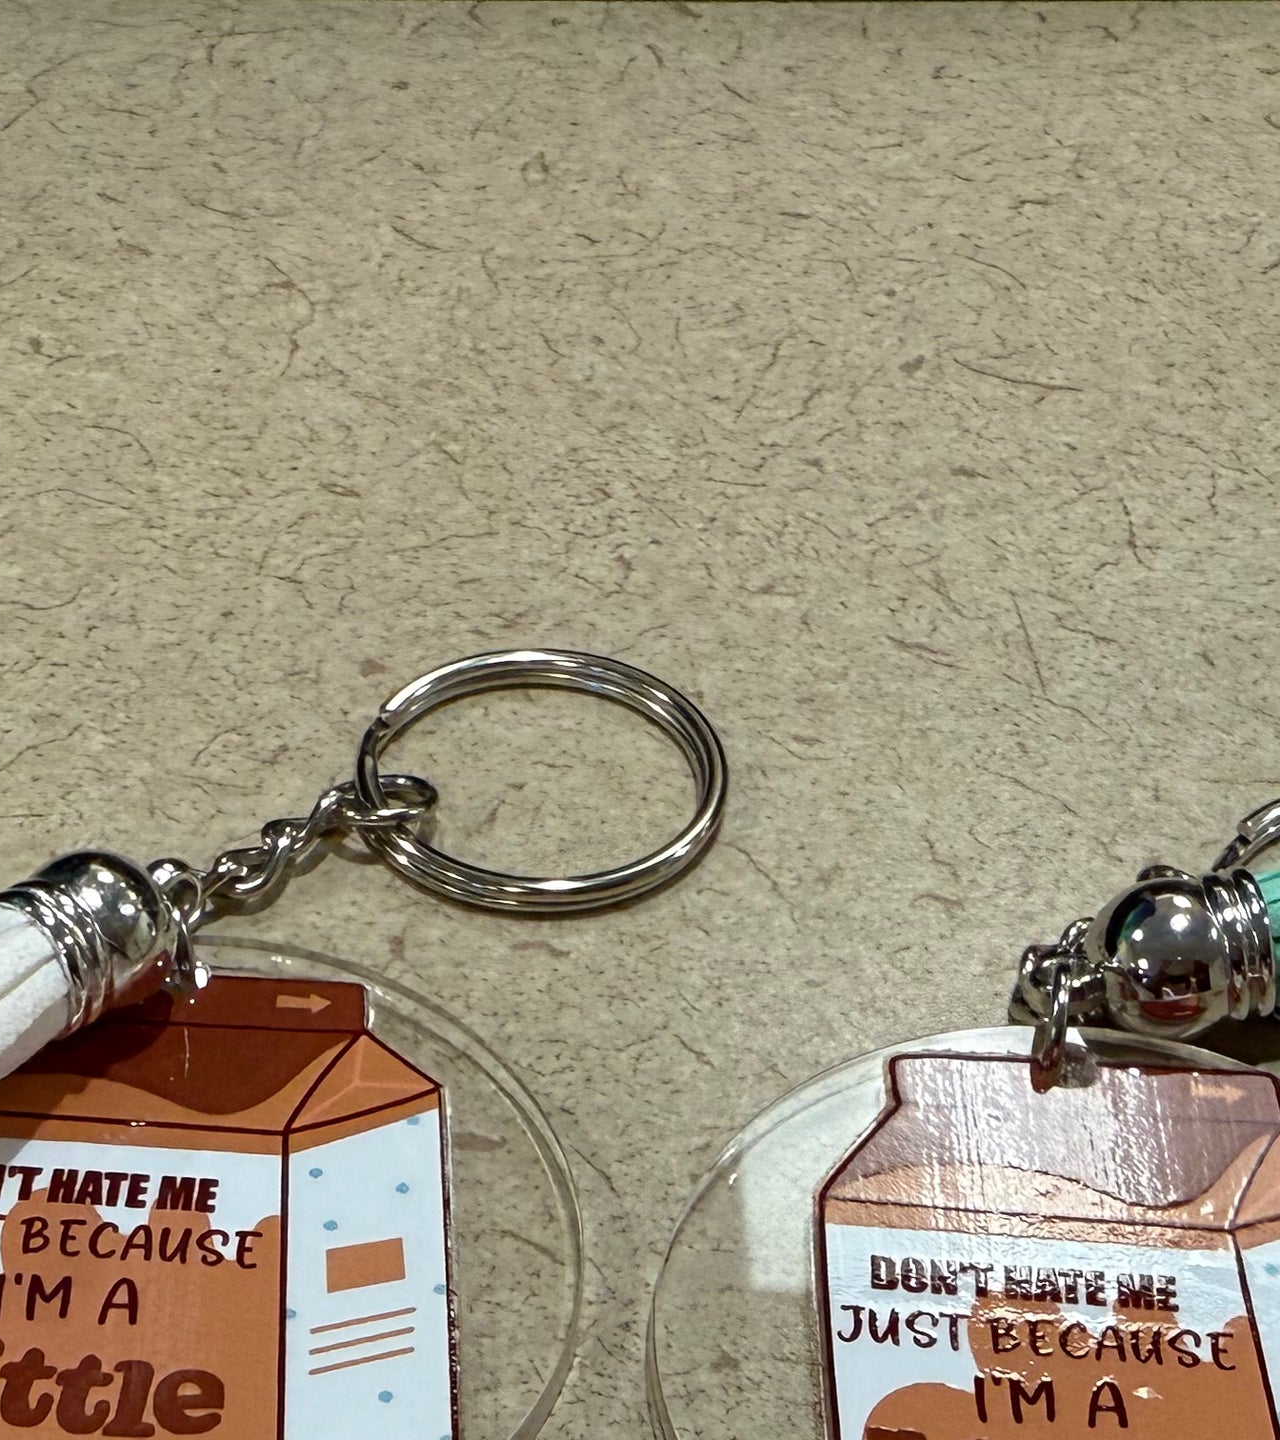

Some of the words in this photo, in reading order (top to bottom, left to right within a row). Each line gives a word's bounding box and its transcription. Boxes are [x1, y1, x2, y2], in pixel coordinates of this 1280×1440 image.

[47, 1167, 150, 1209] HATE
[160, 1174, 220, 1213] ME
[22, 1215, 264, 1270] BECAUSE
[98, 1278, 139, 1325] A
[871, 1254, 994, 1298] DON'T
[1003, 1263, 1105, 1305] HATE
[1117, 1272, 1178, 1312] ME
[837, 1305, 969, 1352] JUST
[990, 1317, 1237, 1371] BECAUSE
[973, 1376, 1056, 1424] I'M
[1088, 1378, 1129, 1428] A
